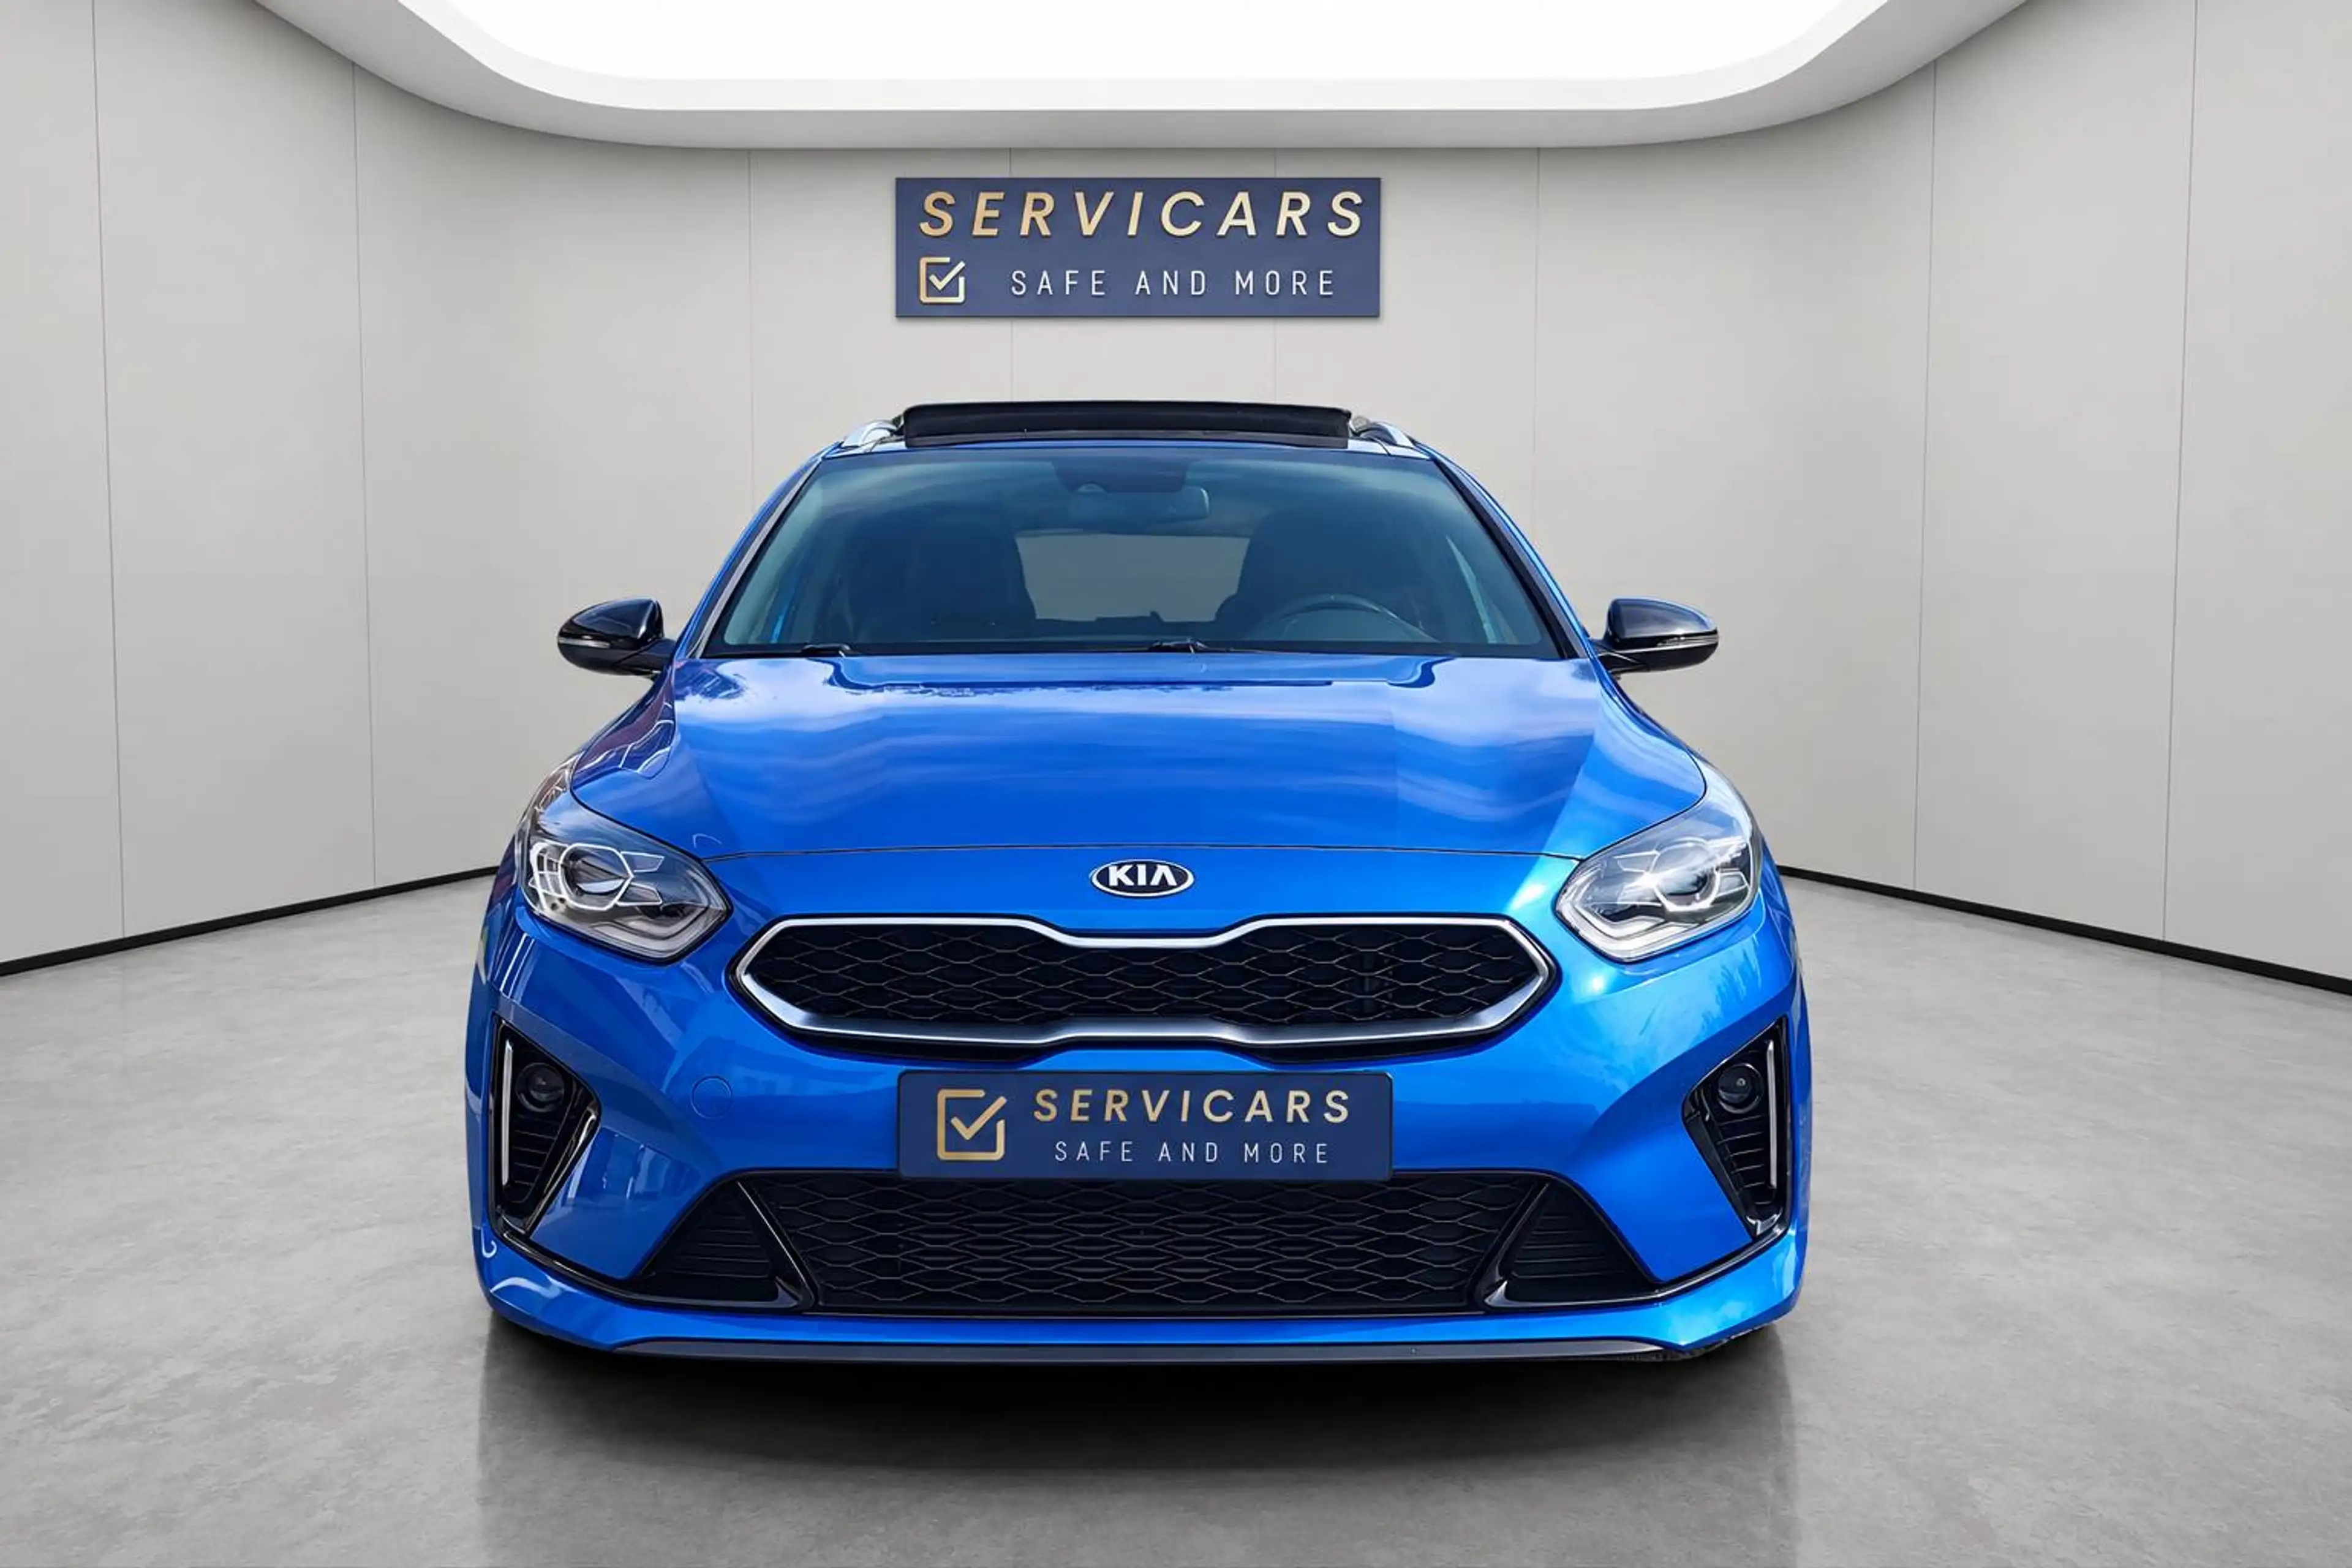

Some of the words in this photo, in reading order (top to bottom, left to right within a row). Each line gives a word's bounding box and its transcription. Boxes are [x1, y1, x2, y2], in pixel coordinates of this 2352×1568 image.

[919, 191, 1362, 236] SERVICARS
[1011, 270, 1105, 295] SAFE
[1136, 270, 1205, 295] AND
[1235, 270, 1333, 295] MORE
[1108, 864, 1177, 886] KIA
[1034, 1089, 1349, 1122] SERVICARS
[1055, 1141, 1132, 1161] SAFE
[1158, 1142, 1218, 1162] AND
[1244, 1142, 1327, 1163] MORE
